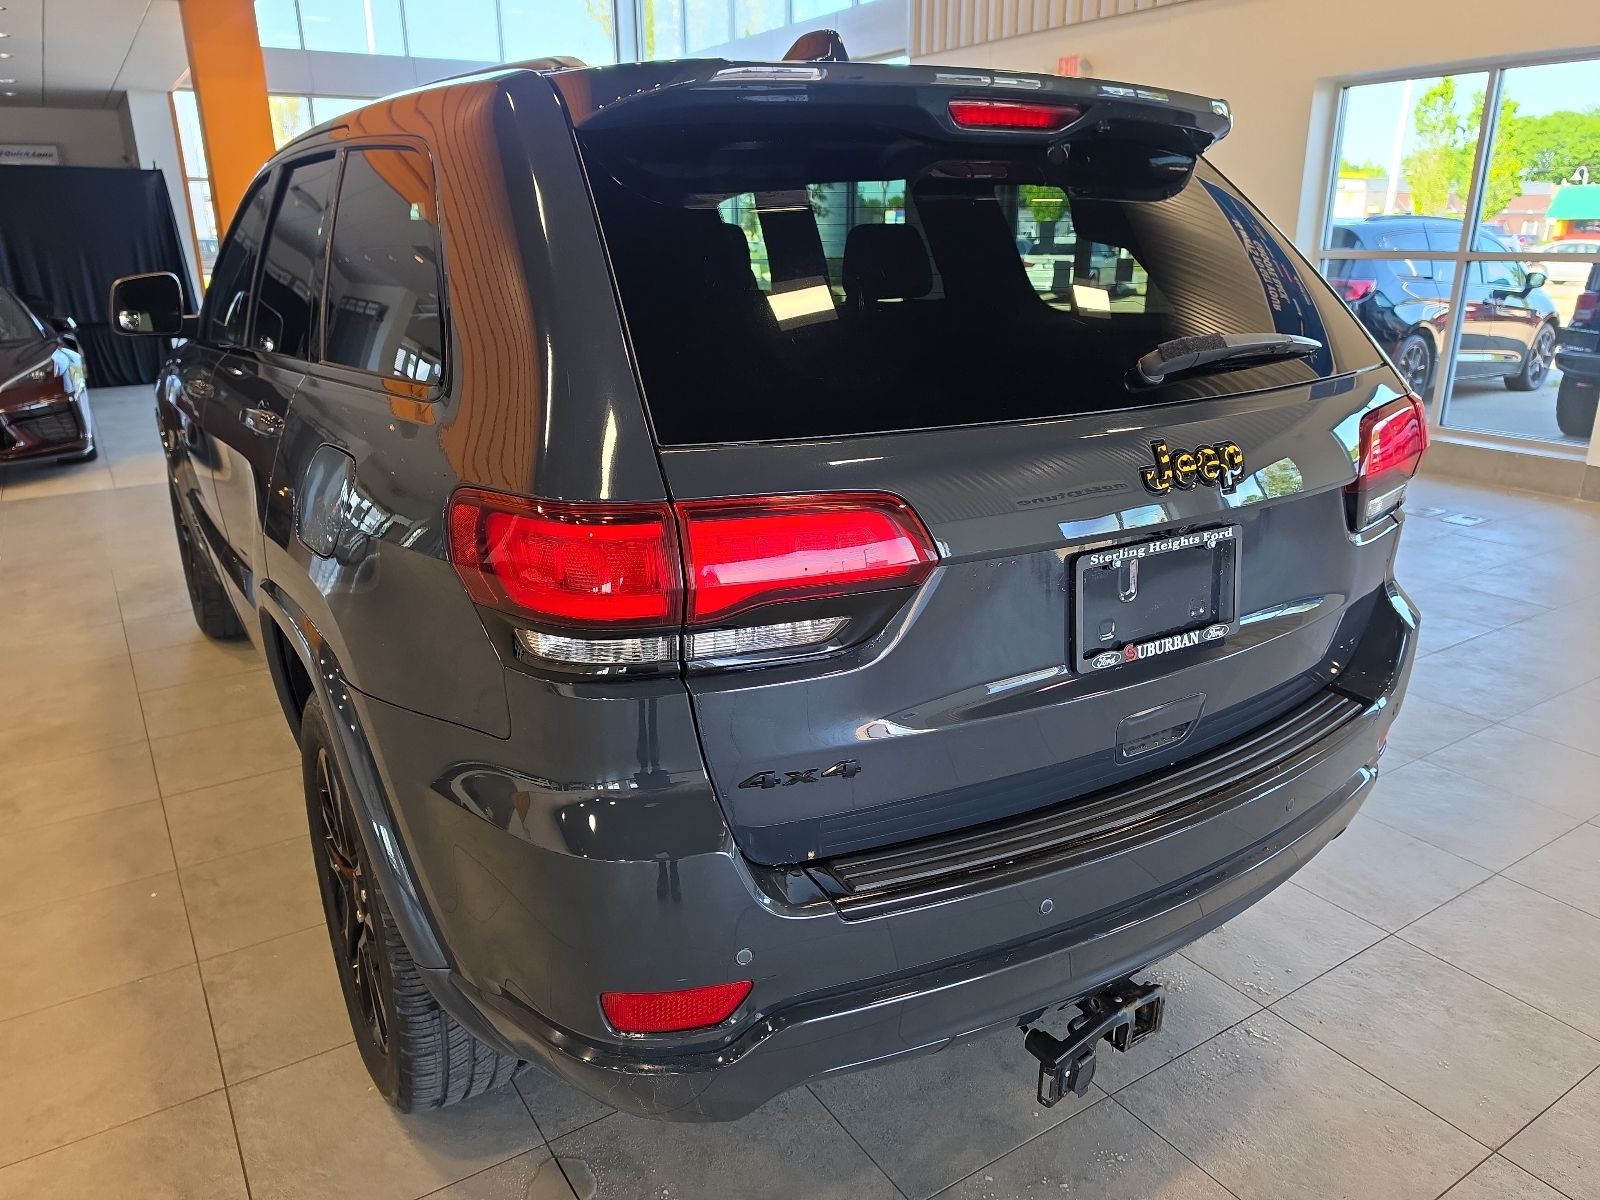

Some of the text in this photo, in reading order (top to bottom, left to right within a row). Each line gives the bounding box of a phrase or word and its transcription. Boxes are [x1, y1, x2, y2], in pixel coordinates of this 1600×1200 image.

[1138, 438, 1245, 496] Jeep
[1090, 528, 1233, 565] Sterling Heights Ford
[1123, 630, 1200, 663] SUBURBAN
[738, 759, 862, 789] 4x4
